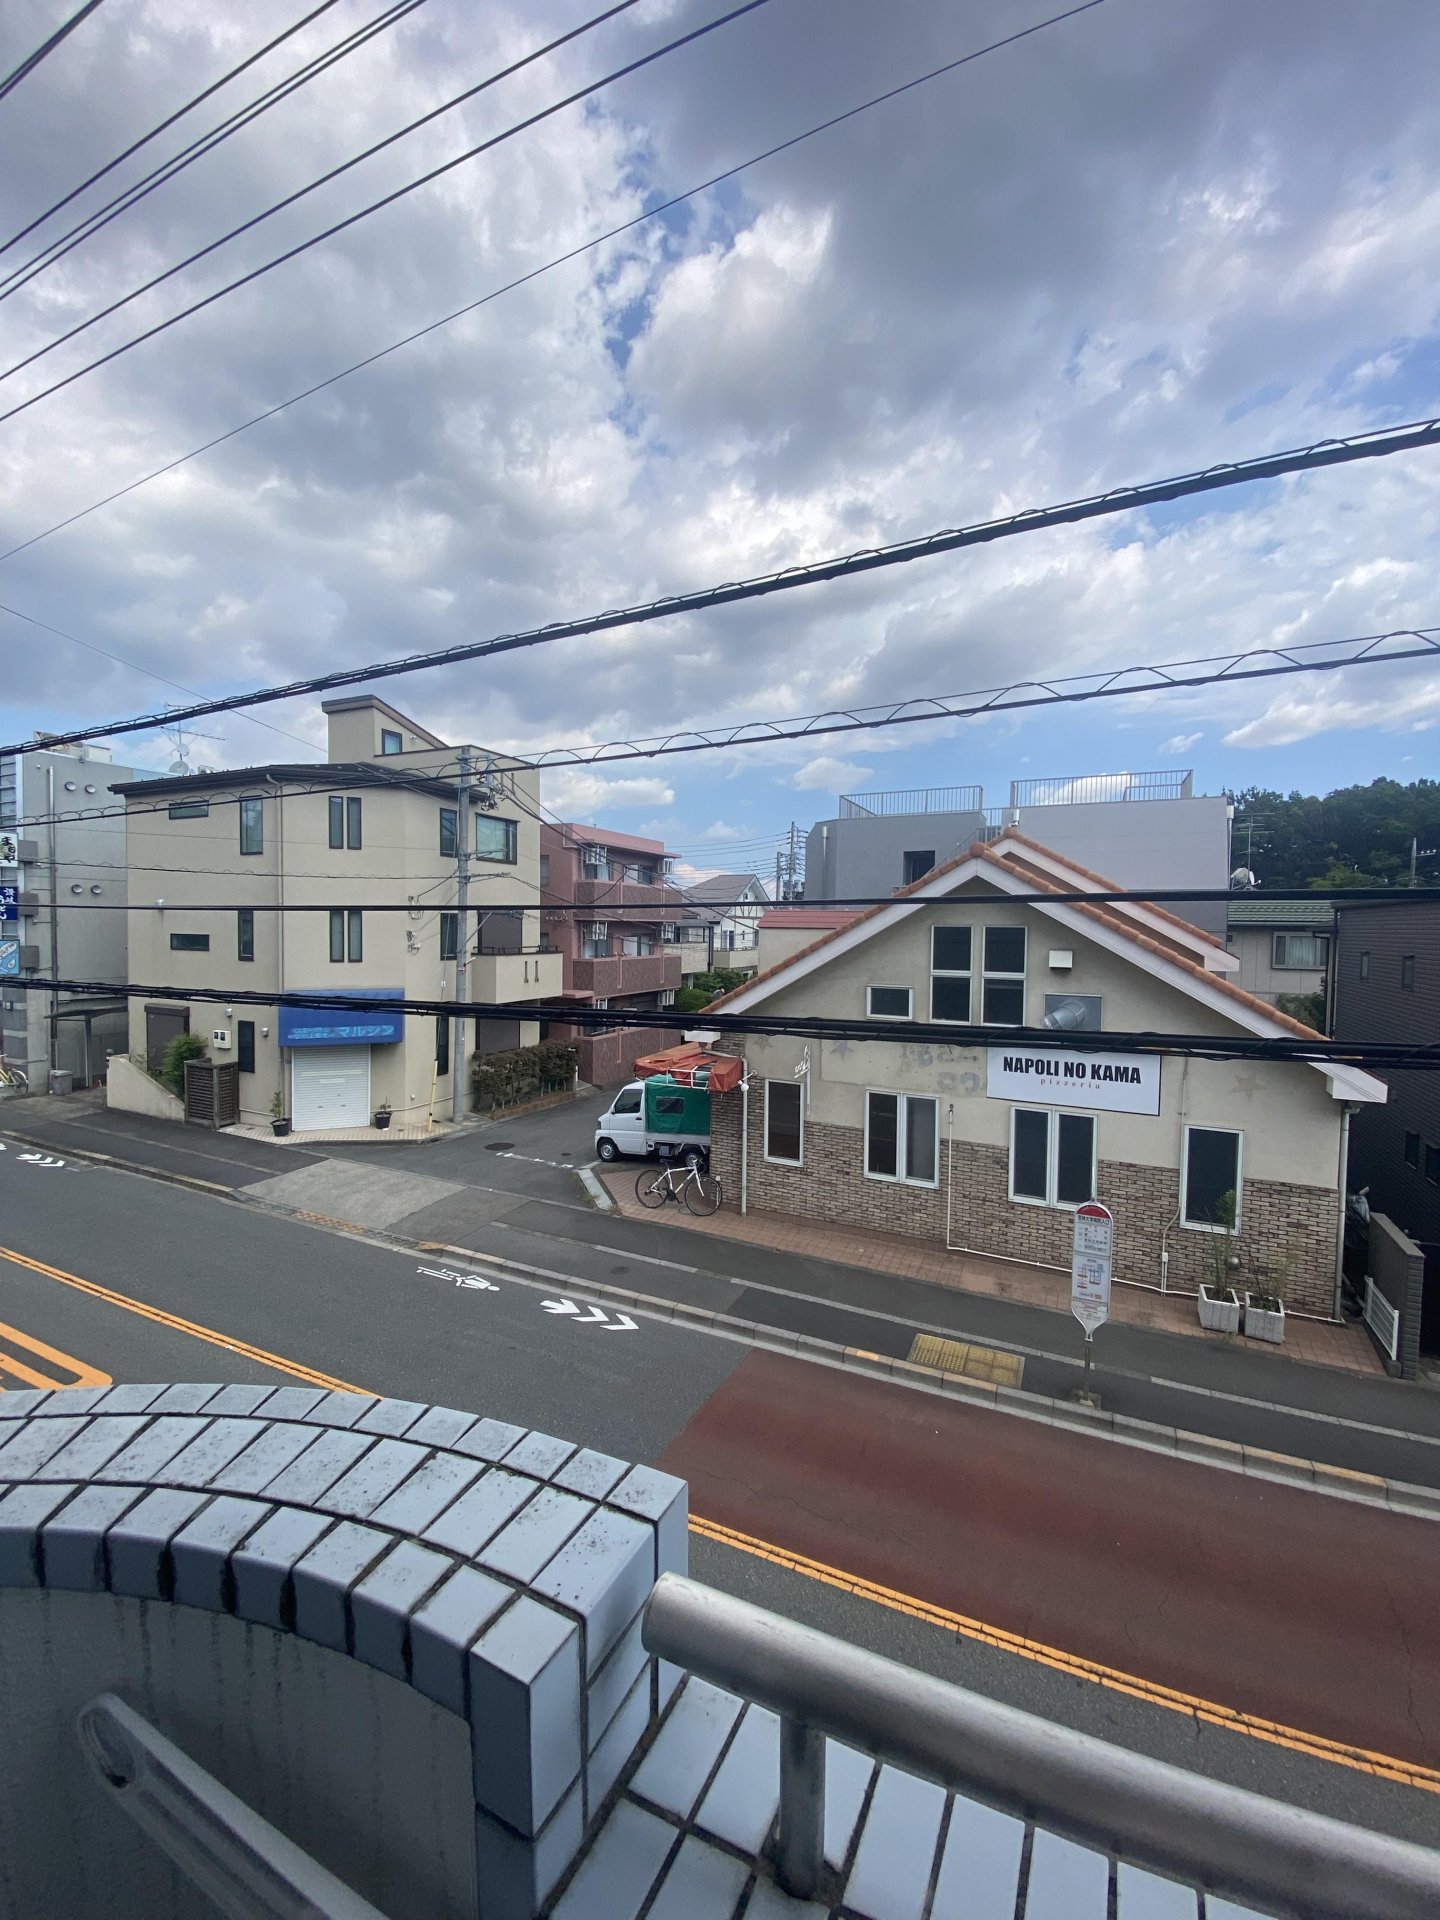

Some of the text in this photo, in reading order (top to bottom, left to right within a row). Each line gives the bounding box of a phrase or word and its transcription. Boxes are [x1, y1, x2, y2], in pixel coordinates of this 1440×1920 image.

[336, 1025, 394, 1037] マルシン
[1003, 1056, 1059, 1077] NAPOLI
[1063, 1061, 1086, 1079] NO
[1090, 1064, 1141, 1084] KAMA
[1040, 1078, 1101, 1090] pizzeria
